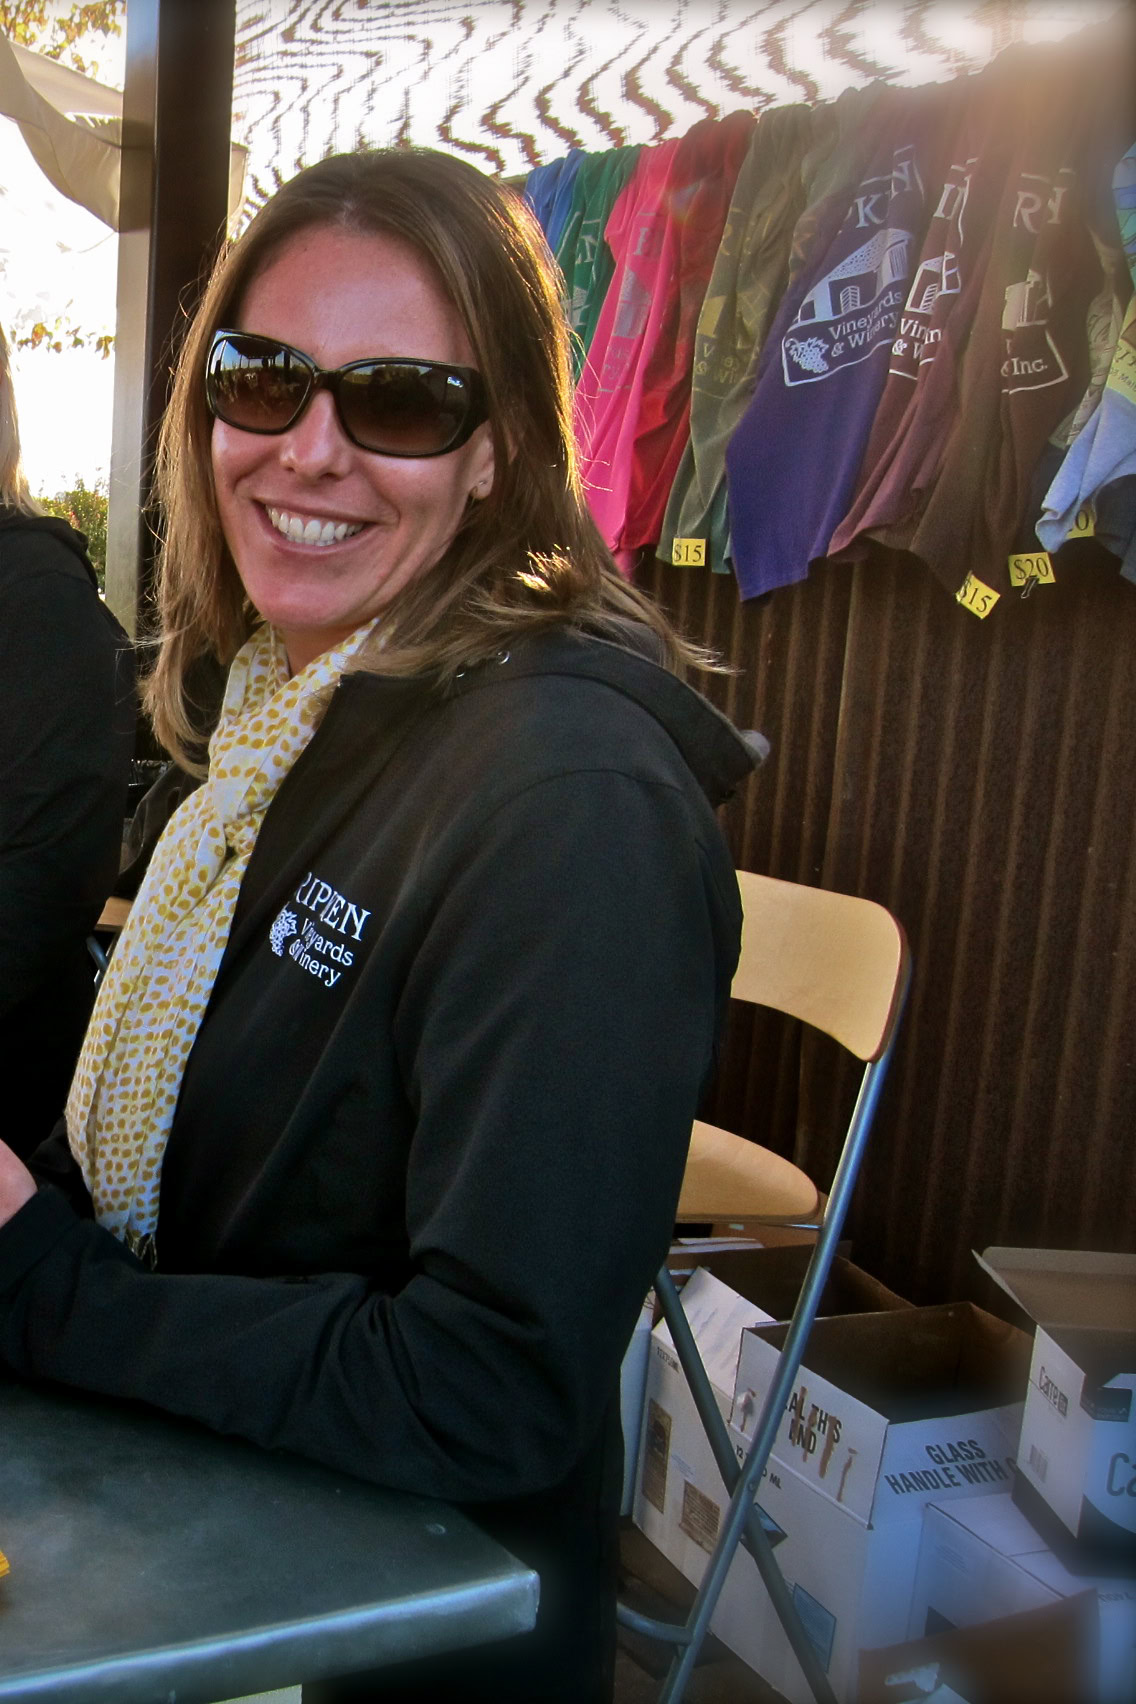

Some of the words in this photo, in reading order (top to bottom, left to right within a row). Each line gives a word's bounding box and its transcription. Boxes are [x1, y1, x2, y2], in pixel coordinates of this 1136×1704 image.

[1014, 558, 1049, 580] $20
[925, 1439, 986, 1465] GLASS
[884, 1467, 961, 1495] HANDLE
[955, 1460, 1009, 1484] WITH
